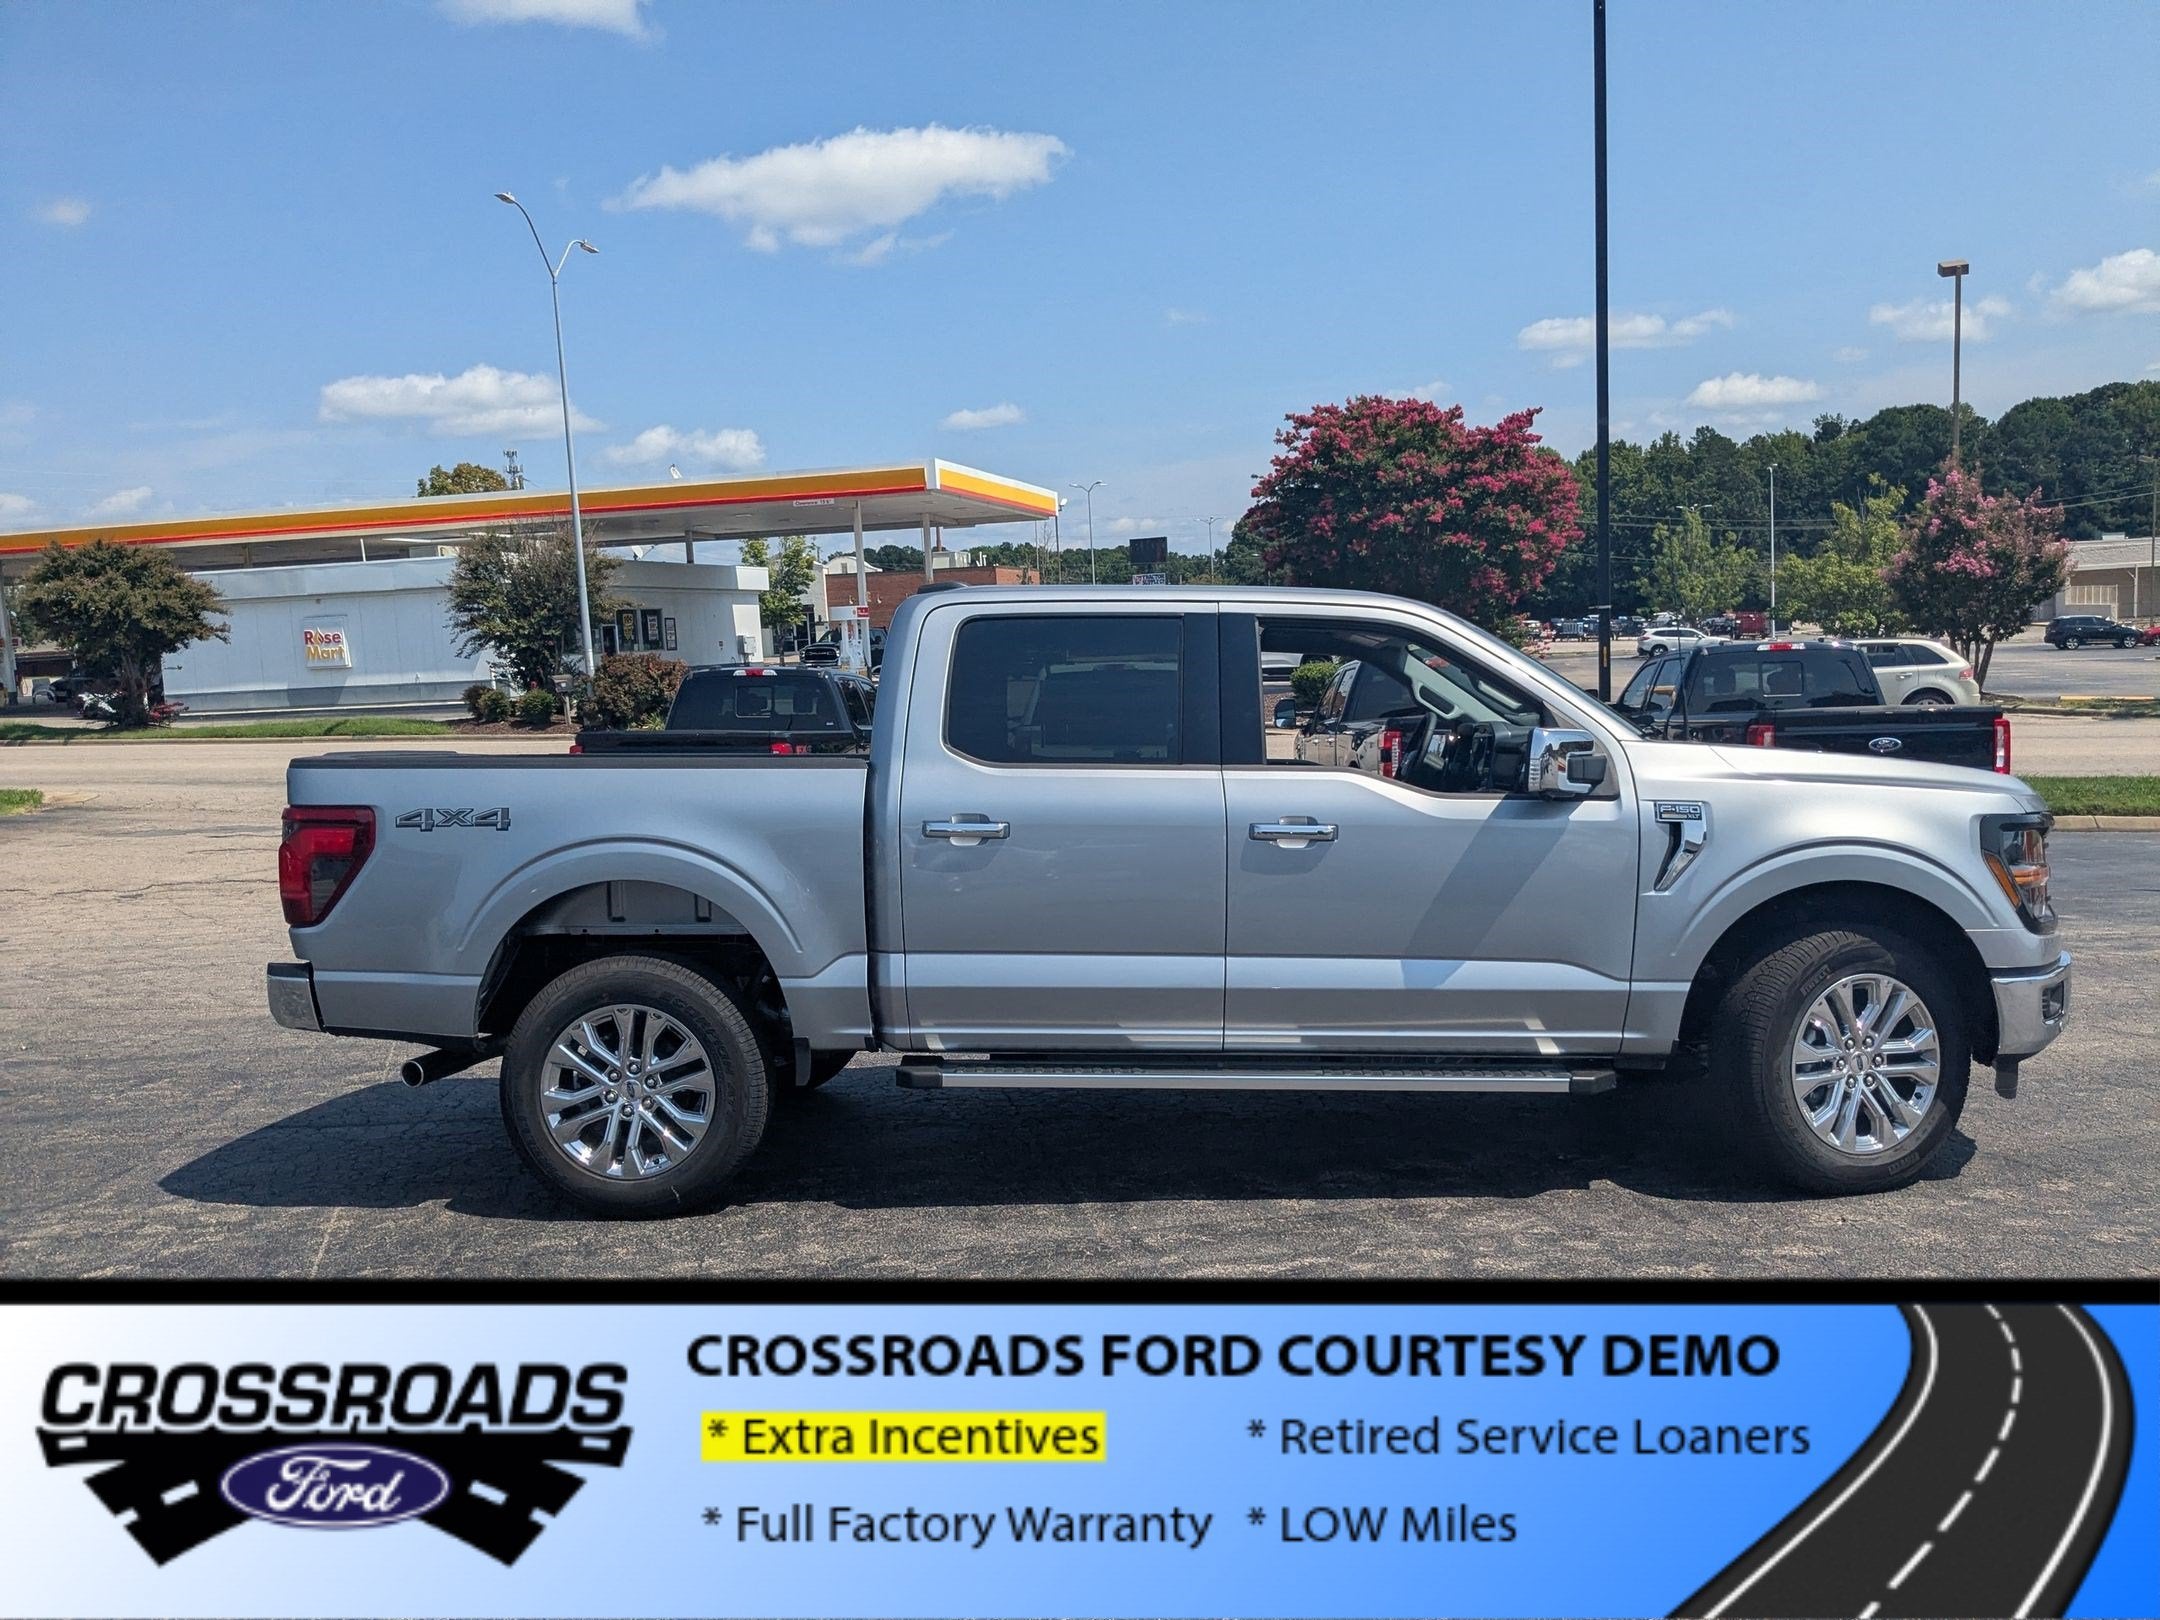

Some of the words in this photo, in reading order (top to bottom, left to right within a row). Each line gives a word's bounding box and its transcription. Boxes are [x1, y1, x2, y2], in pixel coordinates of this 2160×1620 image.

[304, 630, 342, 645] Rose
[306, 645, 345, 660] Mart
[1660, 805, 1700, 813] F-150
